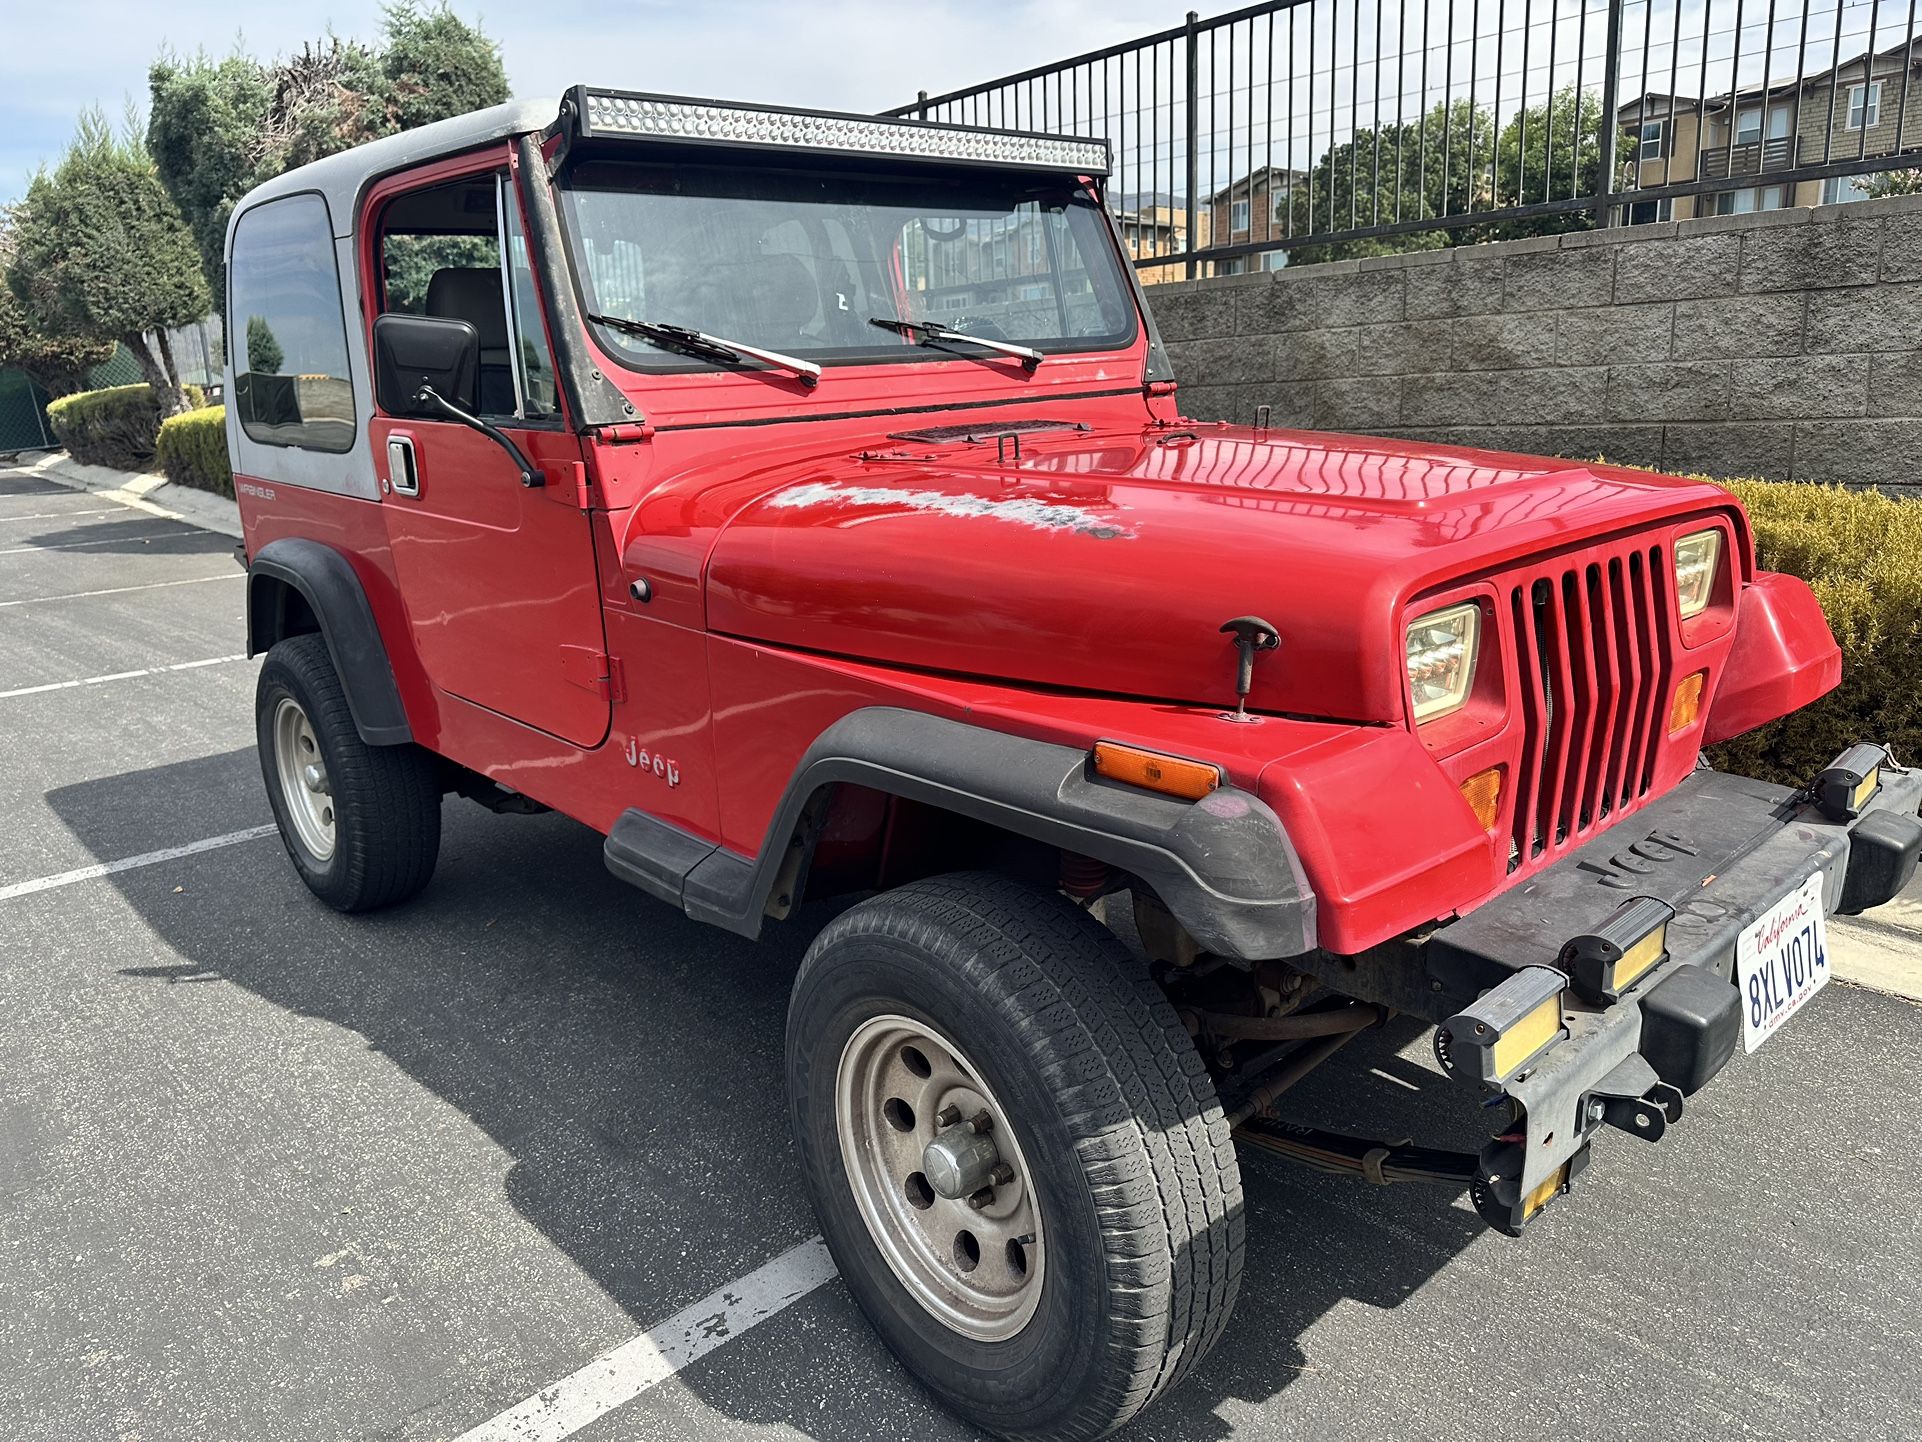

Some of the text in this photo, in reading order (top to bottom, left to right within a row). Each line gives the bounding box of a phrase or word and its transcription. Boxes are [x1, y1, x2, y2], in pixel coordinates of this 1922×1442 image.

[625, 735, 680, 788] Jeep
[1755, 903, 1808, 954] California
[1749, 920, 1825, 1028] 8XLV074
[1768, 984, 1812, 1029] dmv.ca.gov
